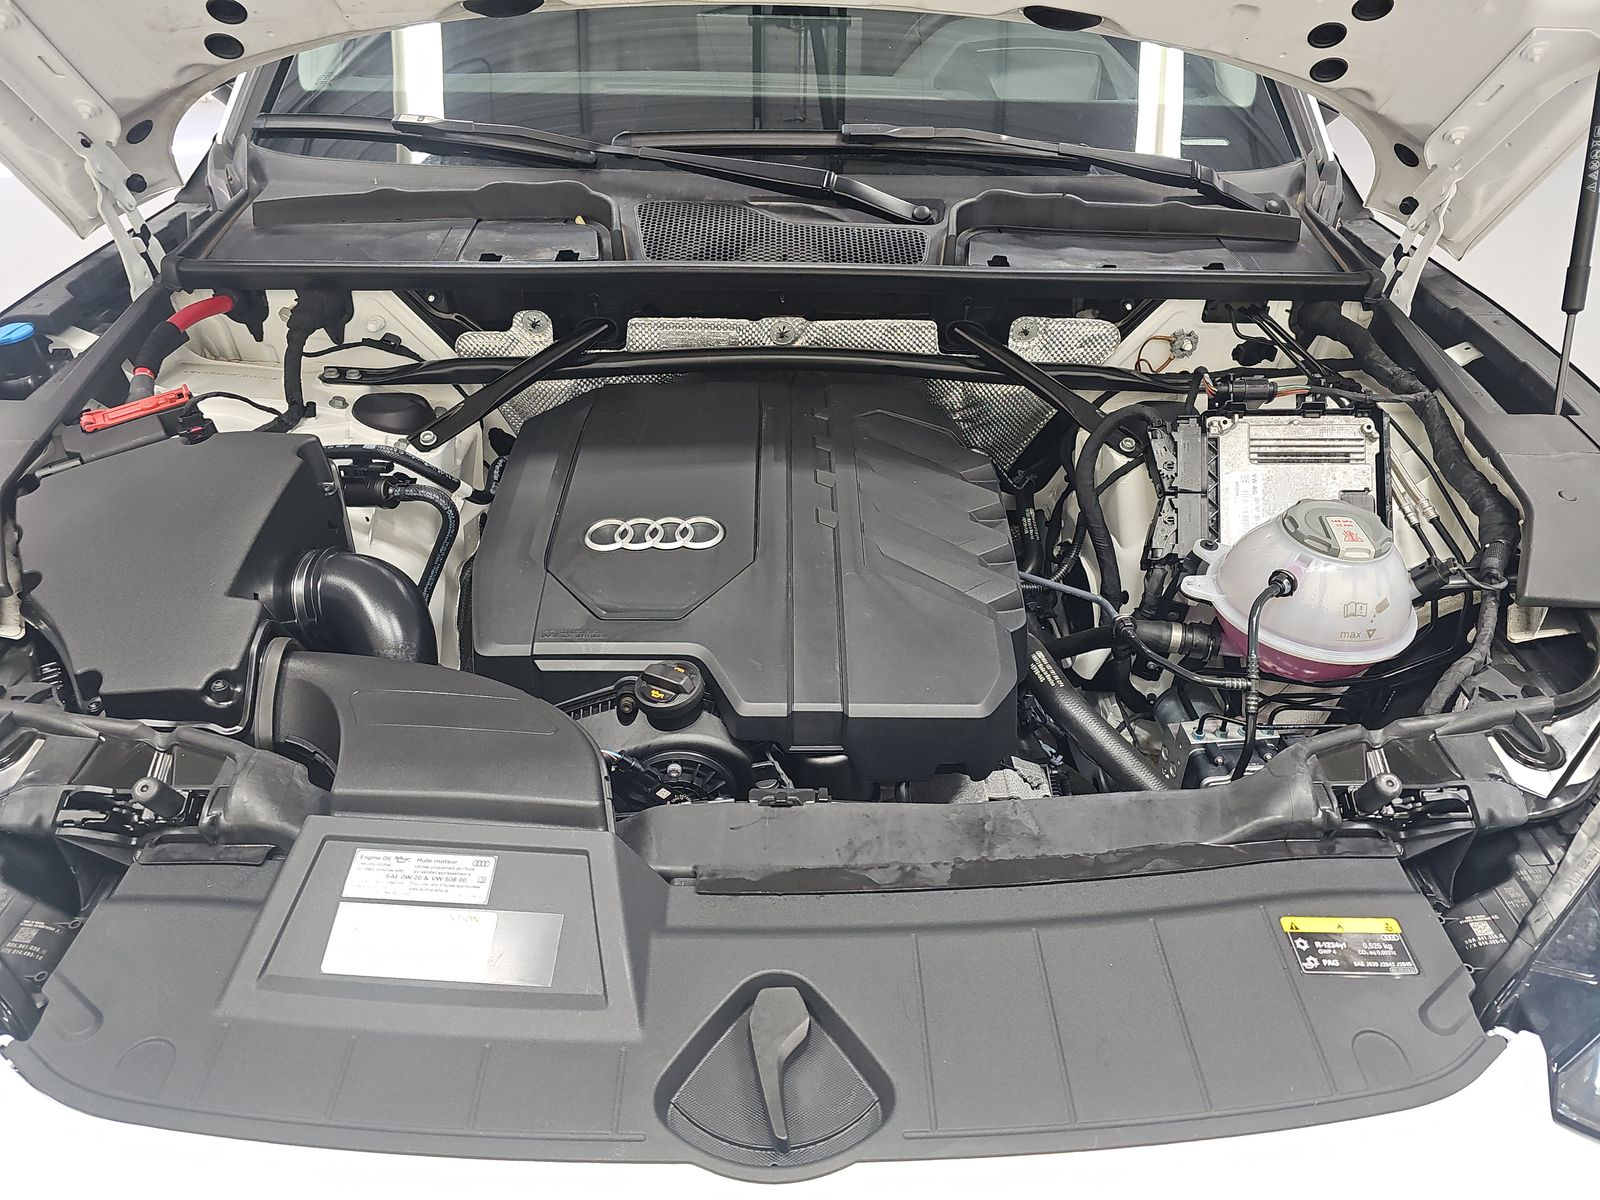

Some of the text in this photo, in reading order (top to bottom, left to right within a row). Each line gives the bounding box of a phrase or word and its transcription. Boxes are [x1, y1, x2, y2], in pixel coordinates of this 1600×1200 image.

[1340, 631, 1361, 639] max
[1314, 941, 1394, 951] R-1234yf 0,525 kg
[1321, 958, 1340, 967] PAG
